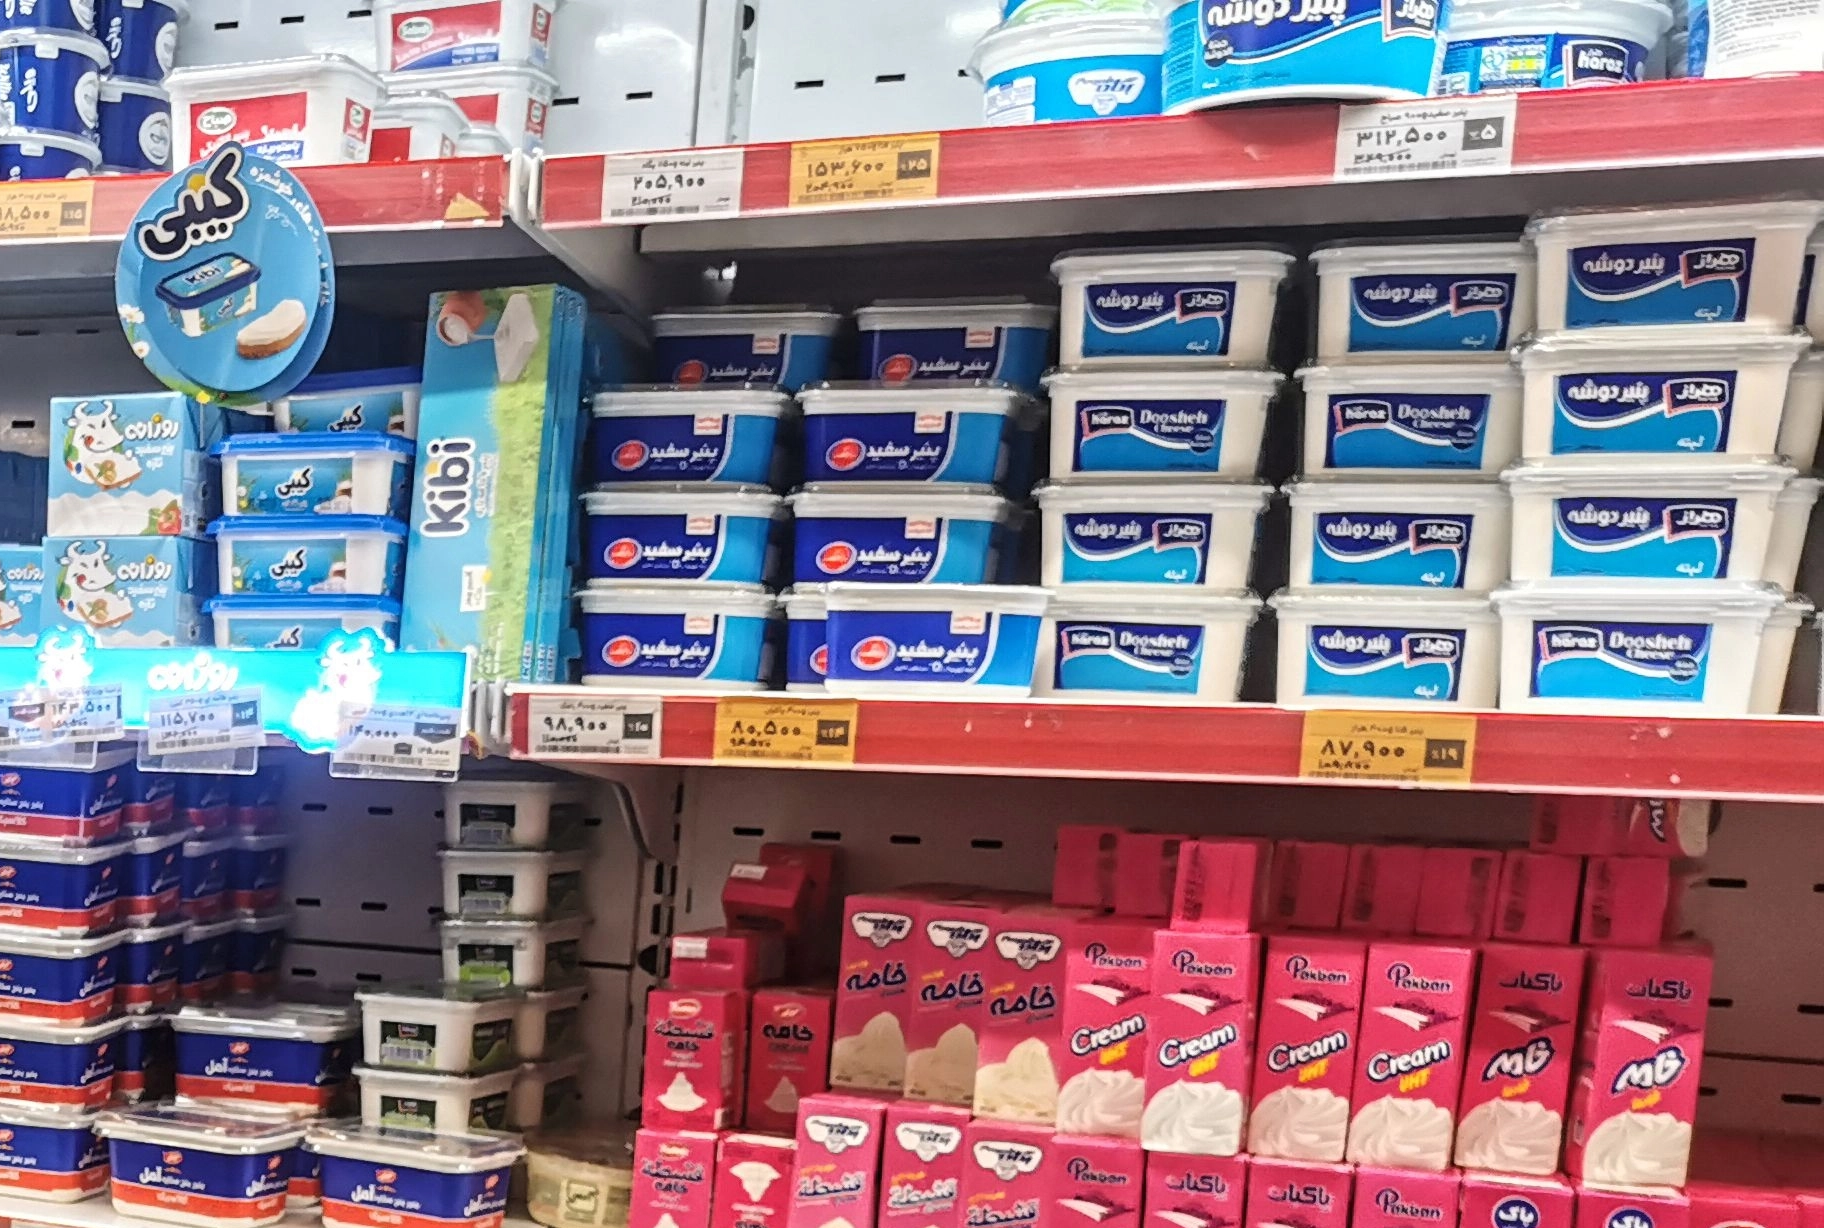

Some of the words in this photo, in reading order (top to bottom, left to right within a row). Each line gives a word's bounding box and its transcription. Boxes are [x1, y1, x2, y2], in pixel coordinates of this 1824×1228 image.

[141, 150, 245, 257] کیبی
[125, 414, 179, 442] روزانه
[117, 556, 172, 581] روزانه
[147, 652, 238, 691] روزانه
[846, 961, 908, 992] خامه
[1172, 950, 1235, 977] Pakban
[1286, 955, 1348, 984] Pakban
[1387, 961, 1451, 992] Pakban
[921, 970, 985, 1002] خامه
[990, 983, 1057, 1017] خامه
[1070, 1014, 1147, 1056] Cream
[1158, 1024, 1237, 1068] Cream
[1268, 1030, 1348, 1073] Cream
[1367, 1039, 1452, 1083] Cream
